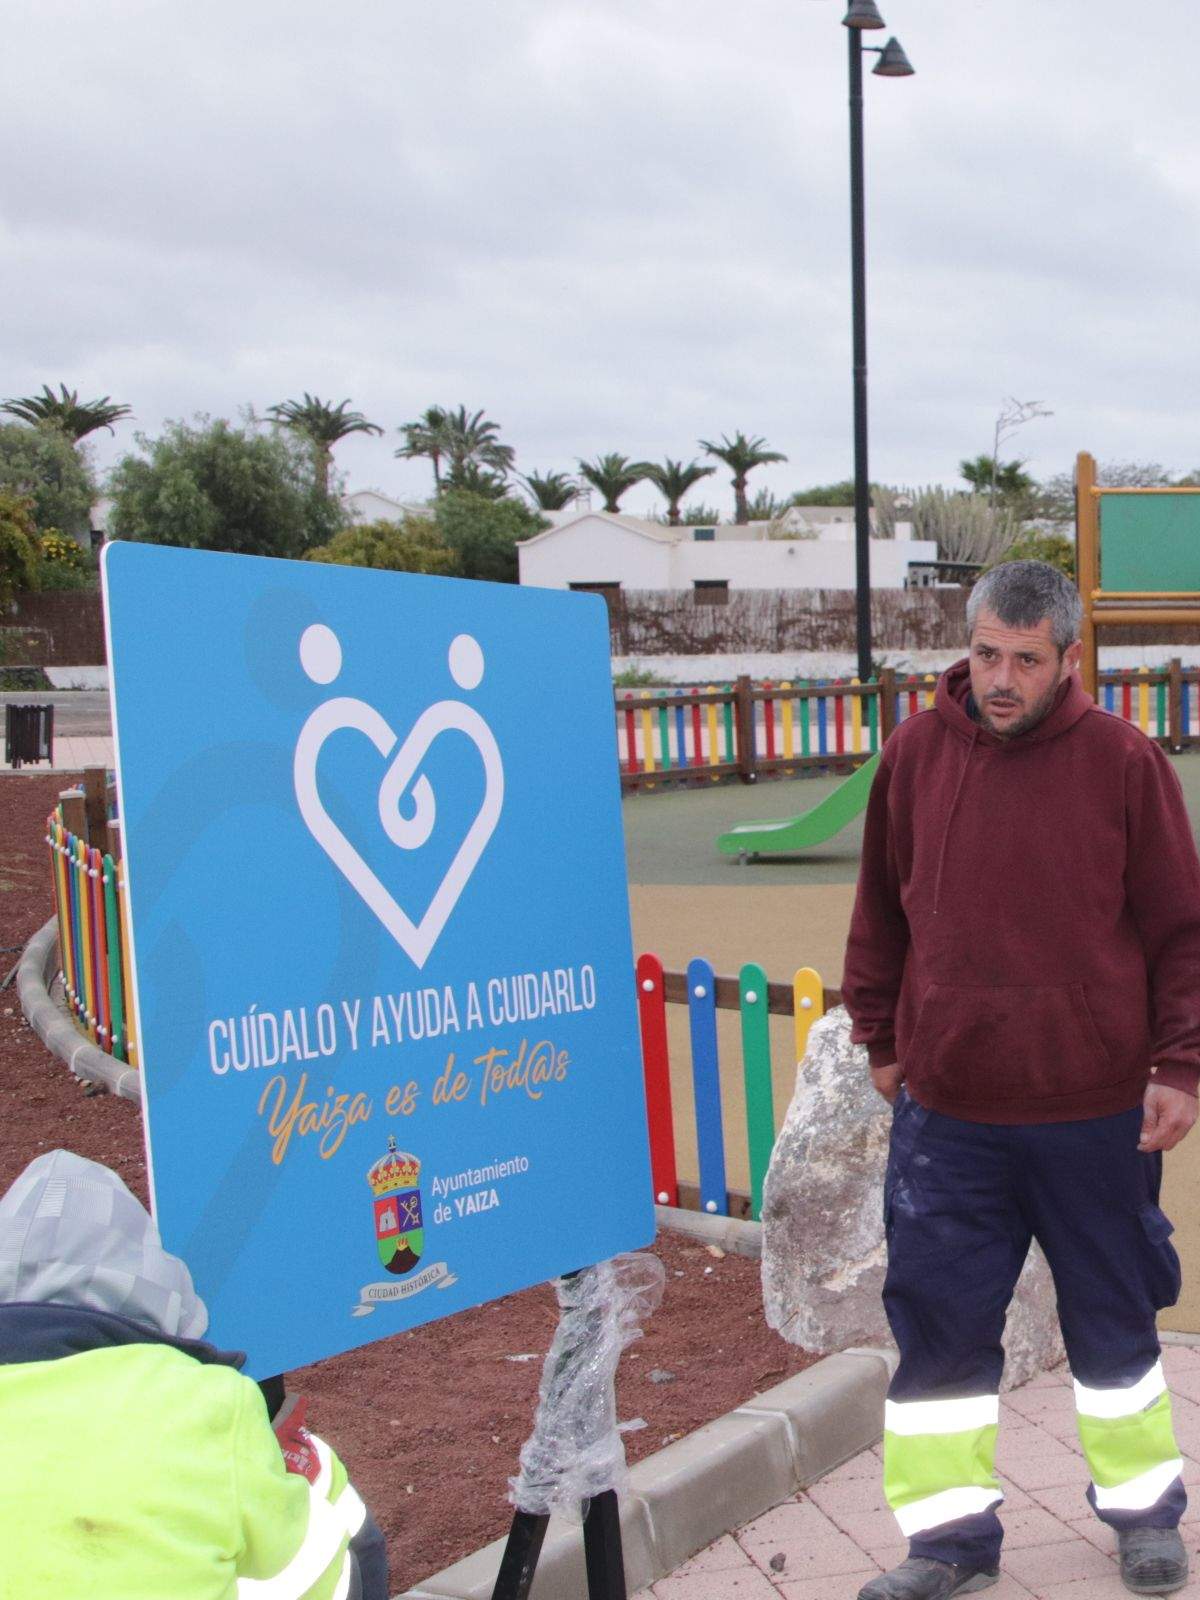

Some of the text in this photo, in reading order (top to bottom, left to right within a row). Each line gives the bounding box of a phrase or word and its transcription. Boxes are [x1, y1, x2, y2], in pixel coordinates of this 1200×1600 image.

[208, 964, 596, 1075] CUÍDALO Y AYUDA A CUIDARLO
[257, 1038, 572, 1165] Yaiza es de Tod@s
[431, 1155, 529, 1199] Ayuntamiento
[433, 1188, 500, 1225] de YAIZA
[368, 1287, 399, 1299] CIUDAD
